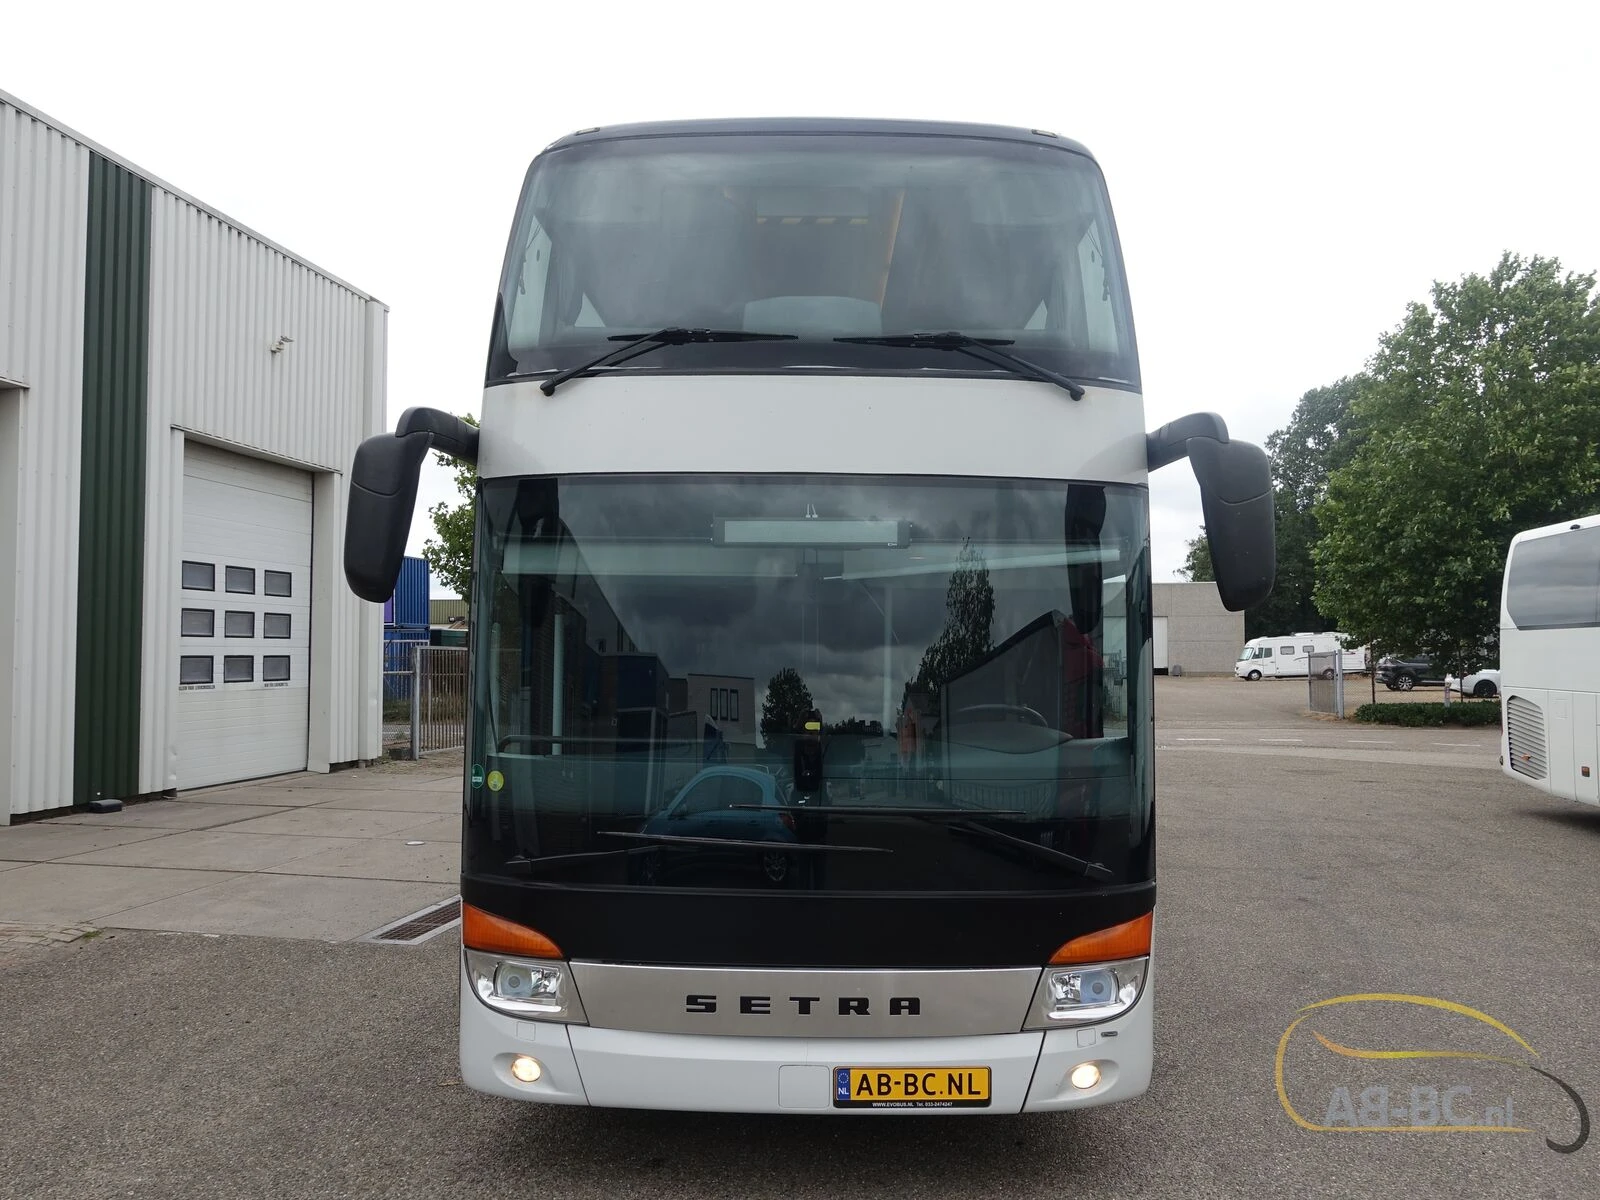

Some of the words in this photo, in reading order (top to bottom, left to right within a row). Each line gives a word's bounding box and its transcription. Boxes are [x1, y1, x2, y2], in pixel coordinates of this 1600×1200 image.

[686, 994, 921, 1016] SETRA
[838, 1087, 849, 1095] NL
[856, 1073, 981, 1096] AB-BC.NL
